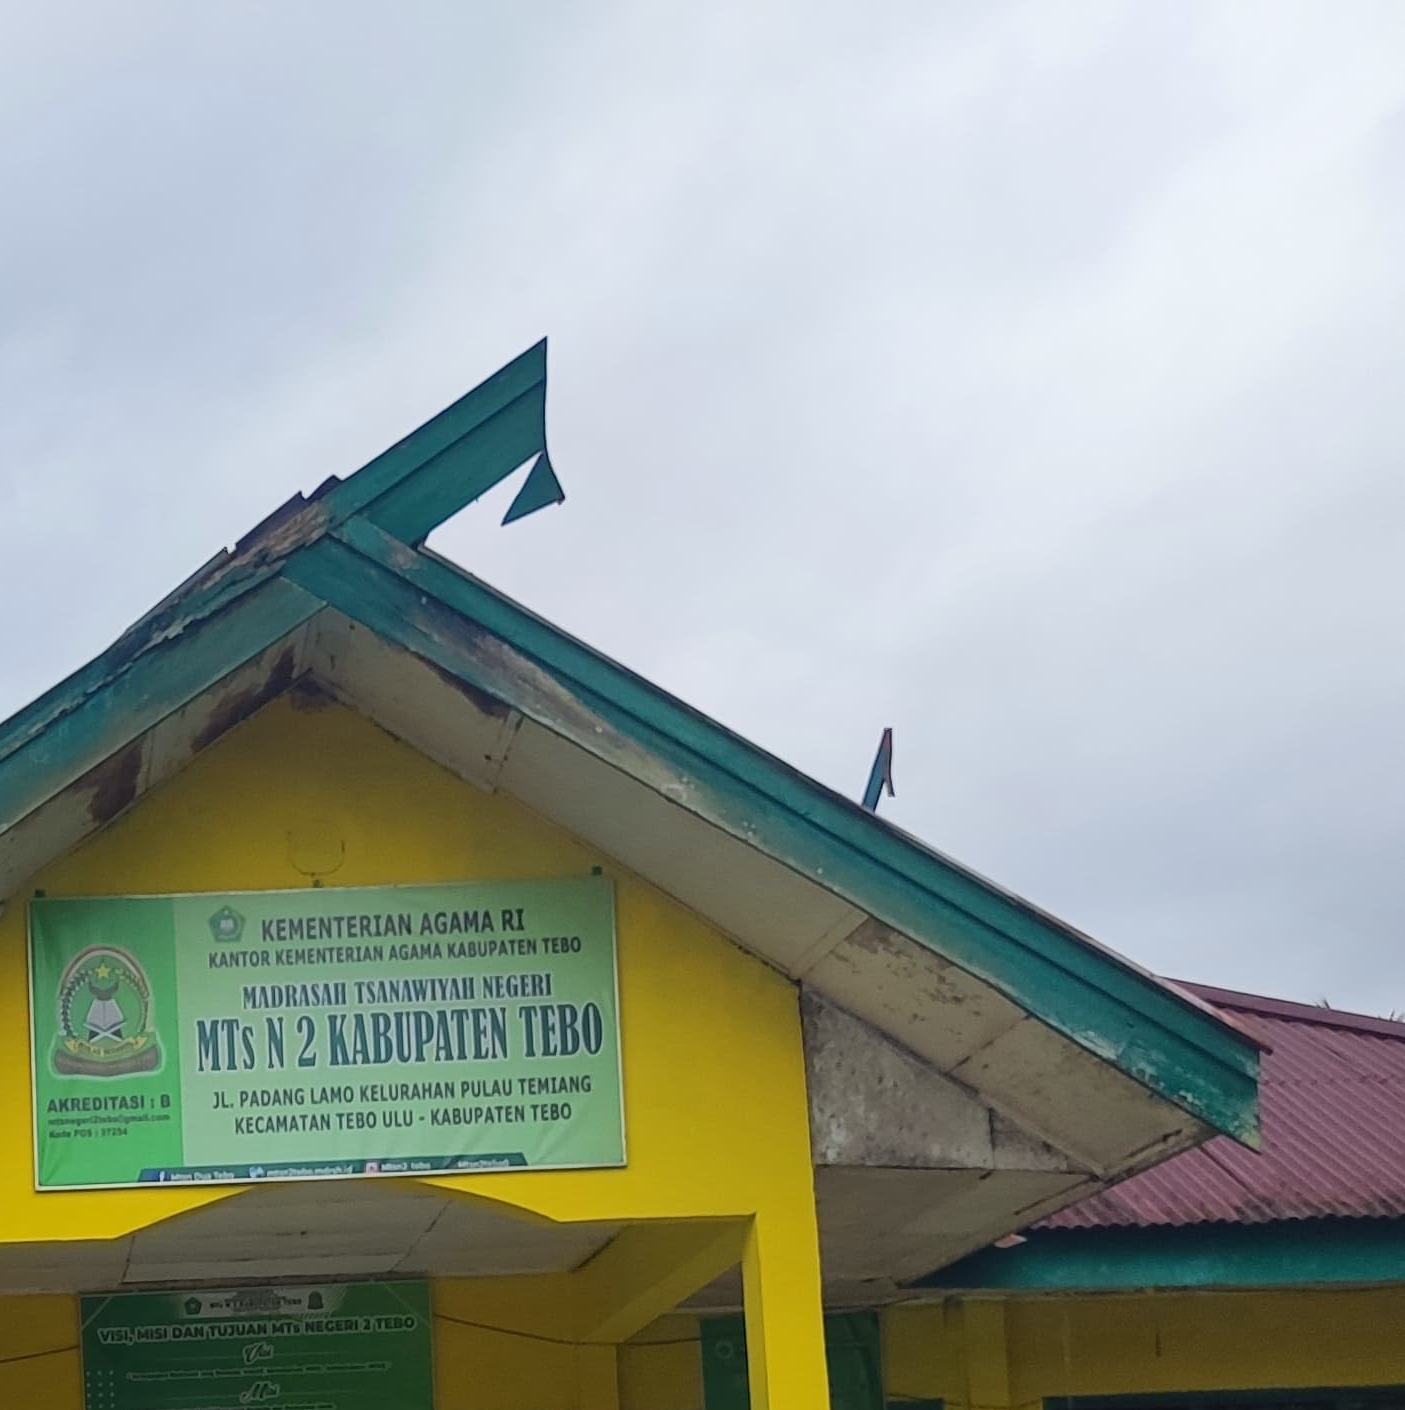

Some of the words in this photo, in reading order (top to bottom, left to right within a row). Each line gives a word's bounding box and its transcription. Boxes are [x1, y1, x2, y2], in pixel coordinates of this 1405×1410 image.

[261, 913, 412, 942] KEMENTERIAN
[420, 909, 495, 935] AGAMA
[501, 908, 525, 931] RI
[208, 950, 271, 968] KANTOR
[275, 945, 384, 967] KEMENTERIAN
[388, 943, 443, 961] AGAMA
[447, 939, 537, 959] KABUPATEN
[541, 936, 582, 954] TEBO
[242, 982, 347, 1009] MADRASAH
[354, 976, 476, 1005] TSANAWIYAH
[482, 973, 552, 999] NEGERI
[196, 1018, 256, 1072] MTs
[265, 1016, 285, 1069] N
[296, 1015, 317, 1068] 2
[327, 1007, 508, 1066] KABUPATEN
[518, 1002, 603, 1058] TEBO
[48, 1095, 145, 1113] AKREDITASI
[160, 1093, 171, 1108] B
[212, 1091, 234, 1109] JL.
[239, 1087, 305, 1108] PADANG
[310, 1085, 354, 1105] LAMO
[359, 1081, 455, 1103] KELURAHAN
[461, 1078, 513, 1099] PULAU
[518, 1075, 592, 1096] TEMIANG
[235, 1113, 331, 1135] KECAMATAN
[336, 1111, 377, 1131] TEBO
[382, 1109, 414, 1128] ULU
[430, 1105, 525, 1127] KABUPATEN
[530, 1102, 572, 1122] TEBO
[98, 1328, 133, 1343] VISI,
[137, 1327, 168, 1341] MISI
[171, 1326, 205, 1339] DAN
[208, 1323, 267, 1337] TUJUAN
[271, 1322, 300, 1335] MTs
[304, 1319, 359, 1333] NEGERI
[363, 1319, 372, 1331] 2
[375, 1316, 415, 1330] TEBO
